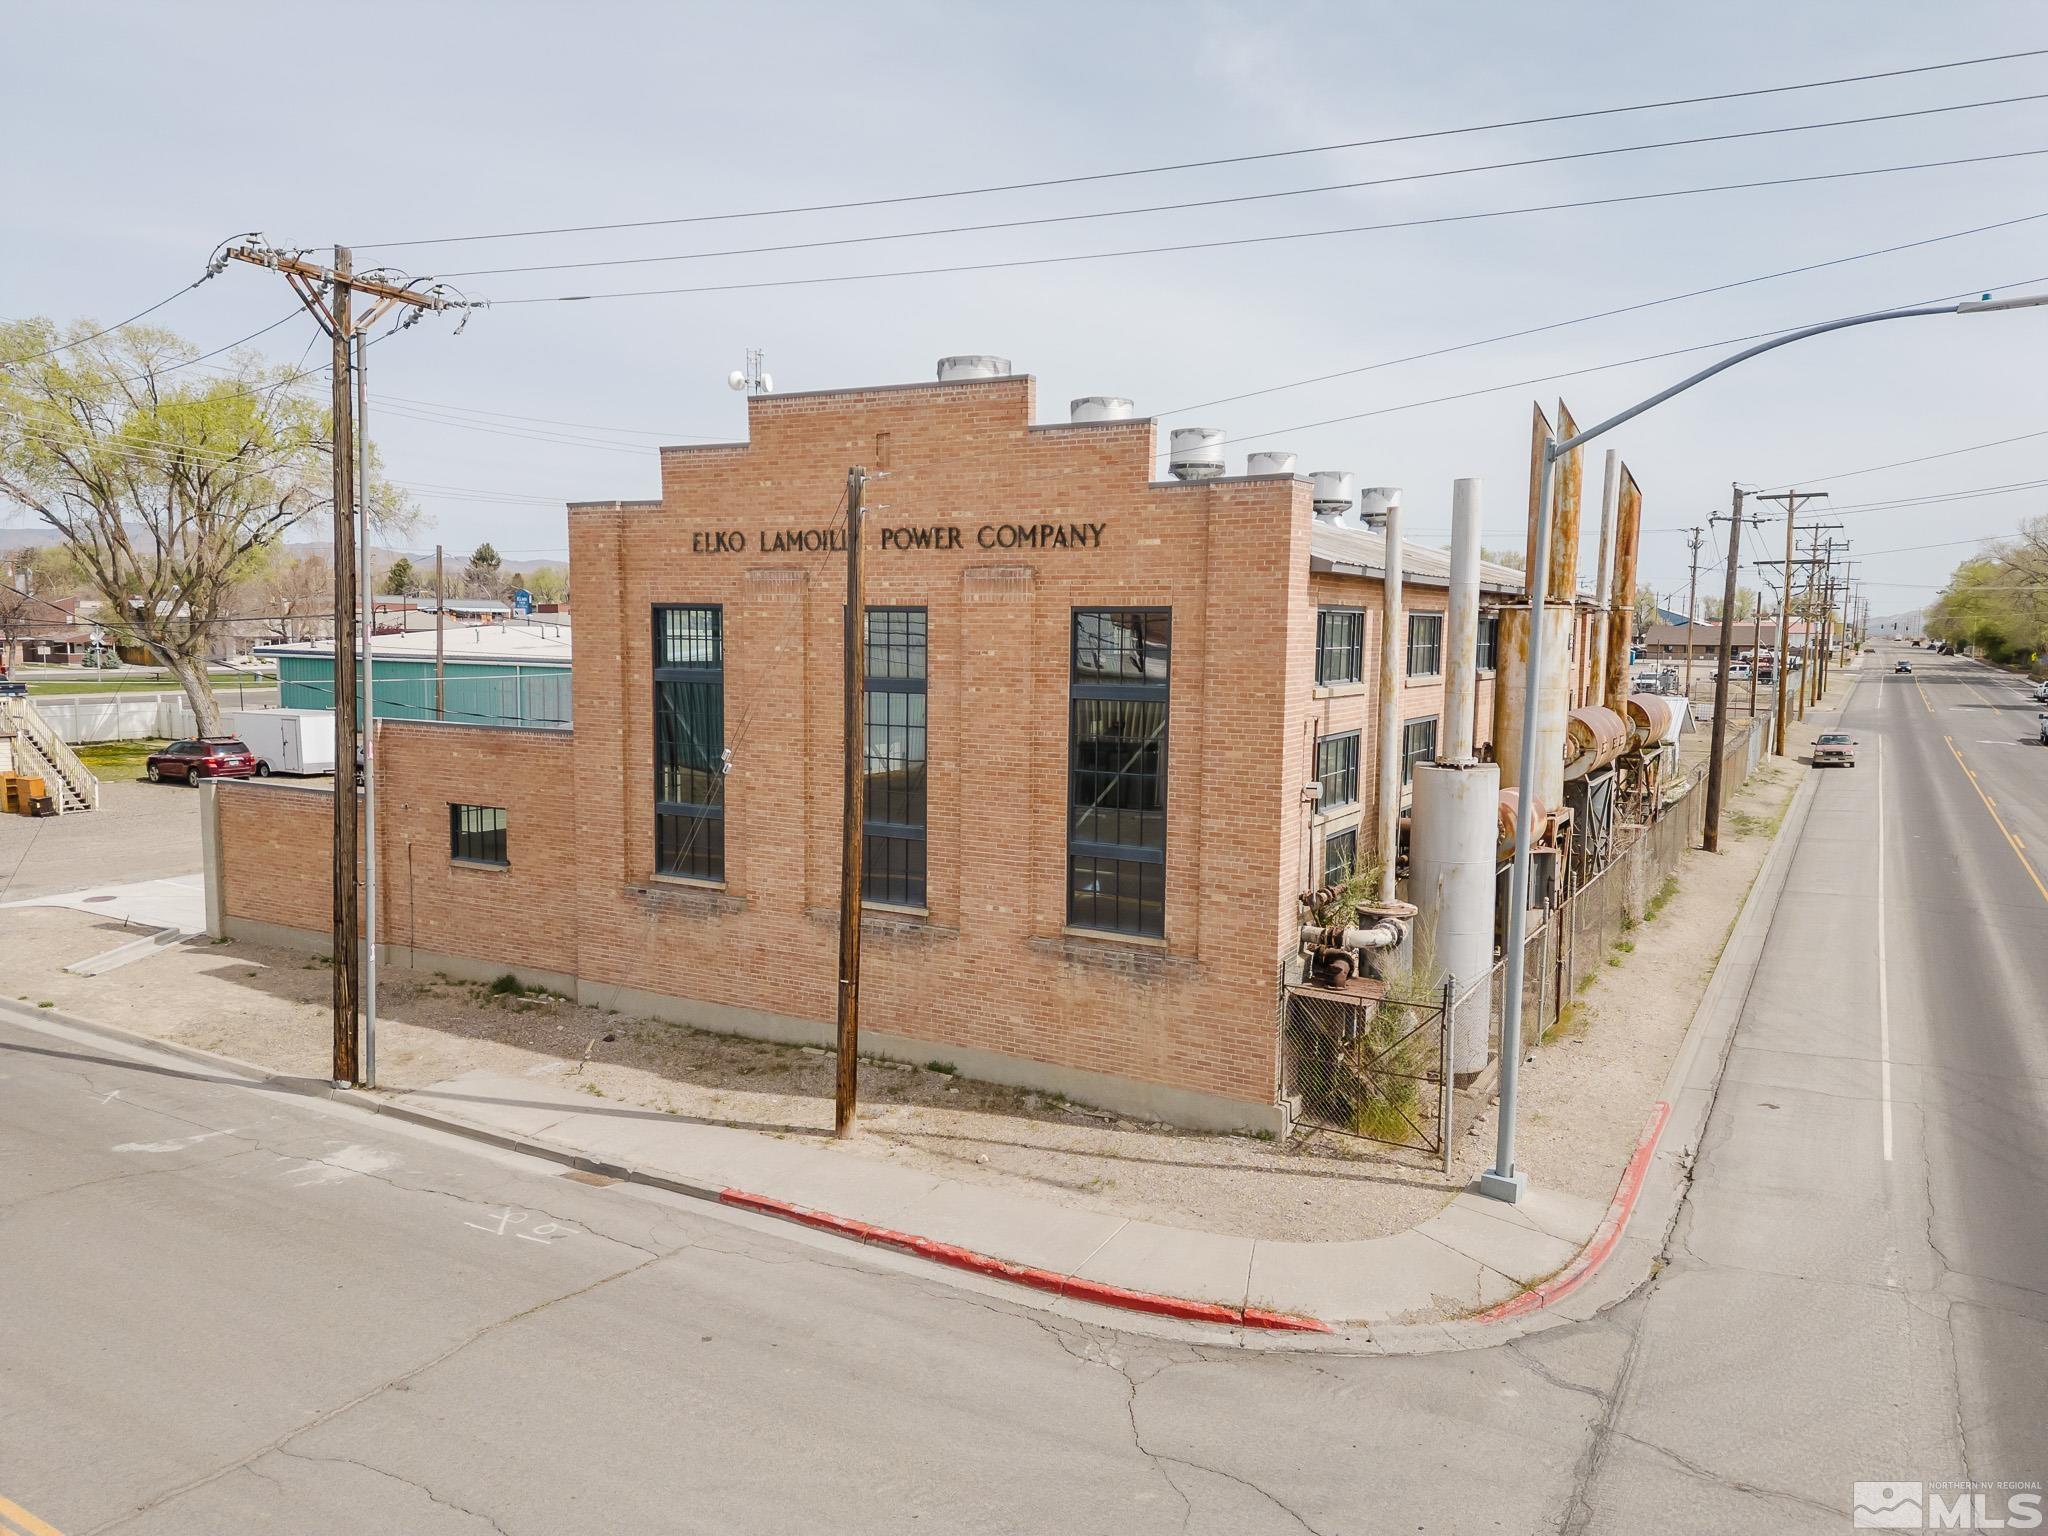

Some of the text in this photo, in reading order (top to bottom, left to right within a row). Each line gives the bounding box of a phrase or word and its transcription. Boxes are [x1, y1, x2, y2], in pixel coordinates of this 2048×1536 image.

[693, 523, 1107, 552] ELKO LAMOILL POWER COMPANY
